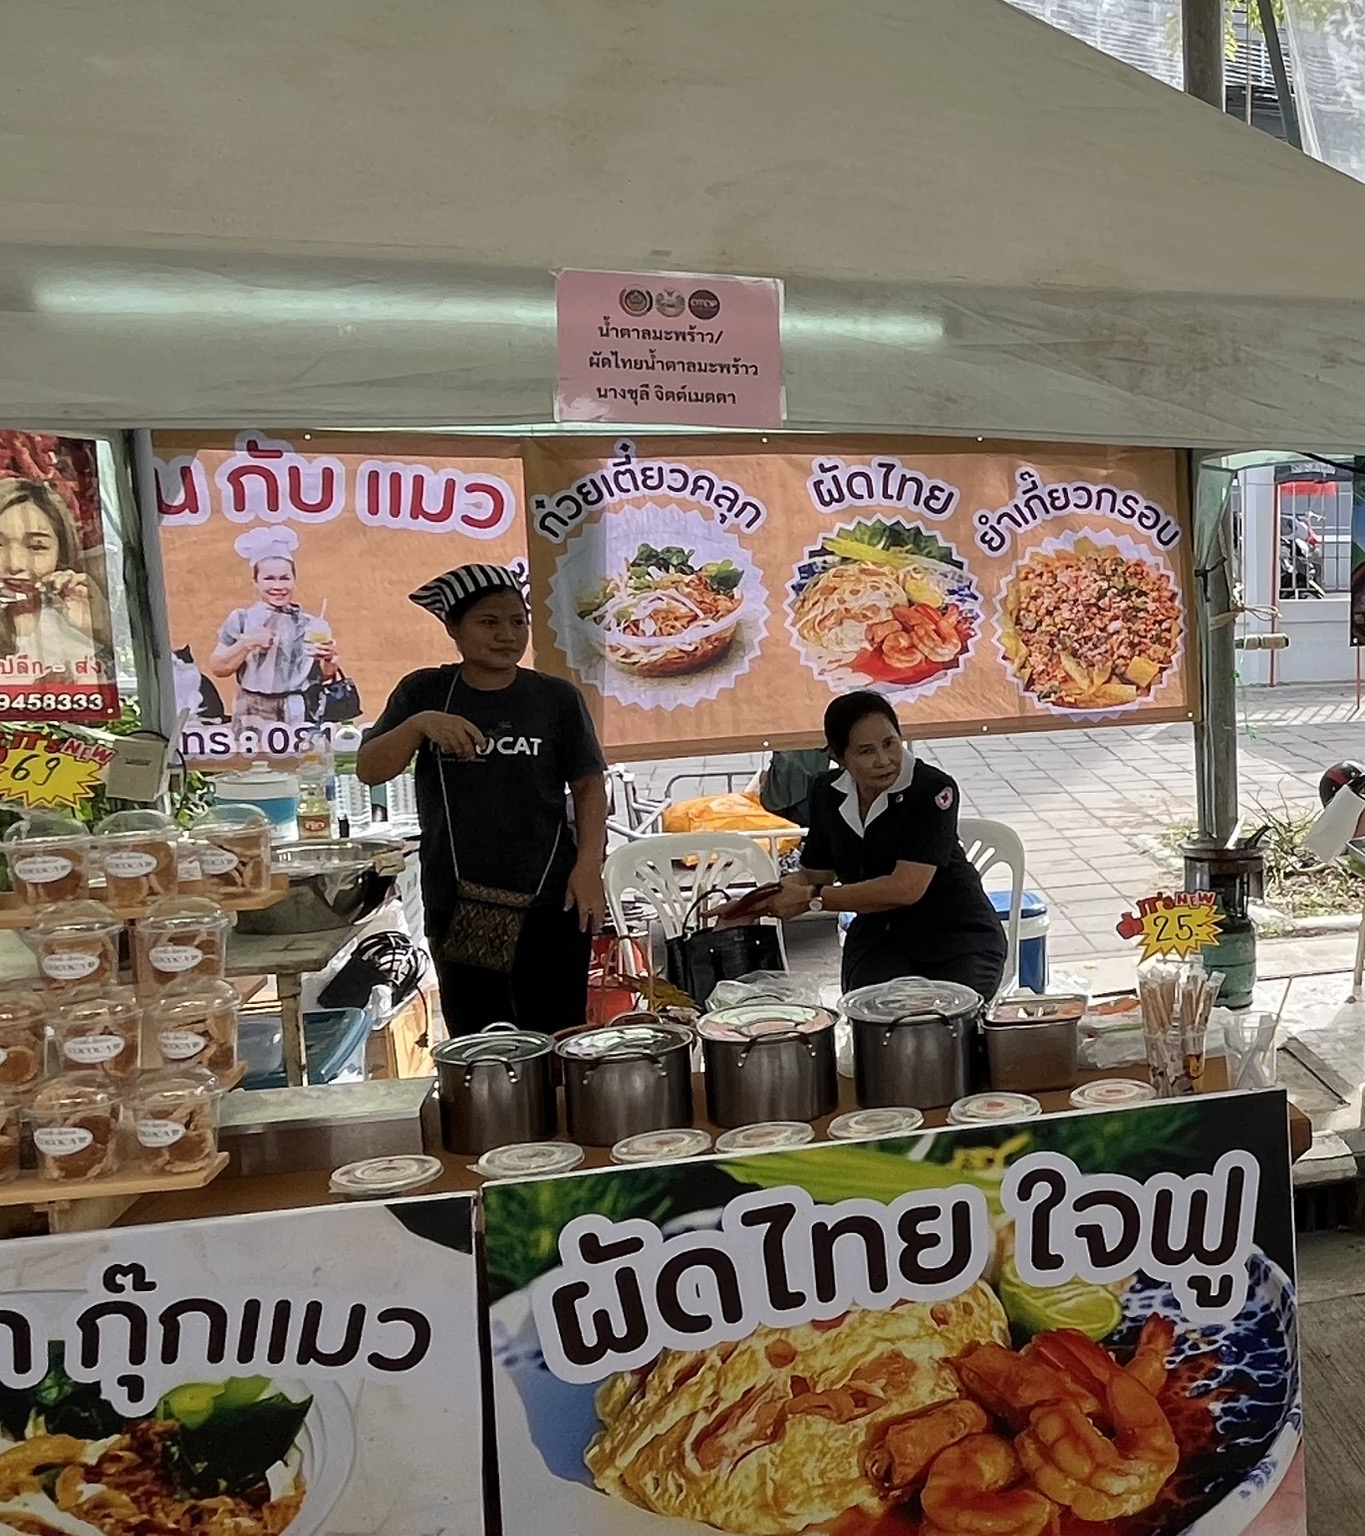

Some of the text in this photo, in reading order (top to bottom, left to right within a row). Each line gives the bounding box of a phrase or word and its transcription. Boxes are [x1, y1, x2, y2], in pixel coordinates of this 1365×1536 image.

[598, 315, 723, 345] น้ำตาลมะพร้าว/
[589, 349, 759, 377] ผัดไทยน้ำตาลมะพร้าว
[226, 439, 335, 514] กับ
[366, 469, 506, 530] แมว
[813, 461, 955, 514] ผัดไทย
[979, 470, 1180, 553] ยำเกี๊ยวกรอบ
[10, 753, 61, 787] 69
[1175, 889, 1216, 909] NEW
[550, 1166, 1248, 1357] ผัดไทย ใจฟู
[76, 1262, 433, 1404] กุ๊กแมว
